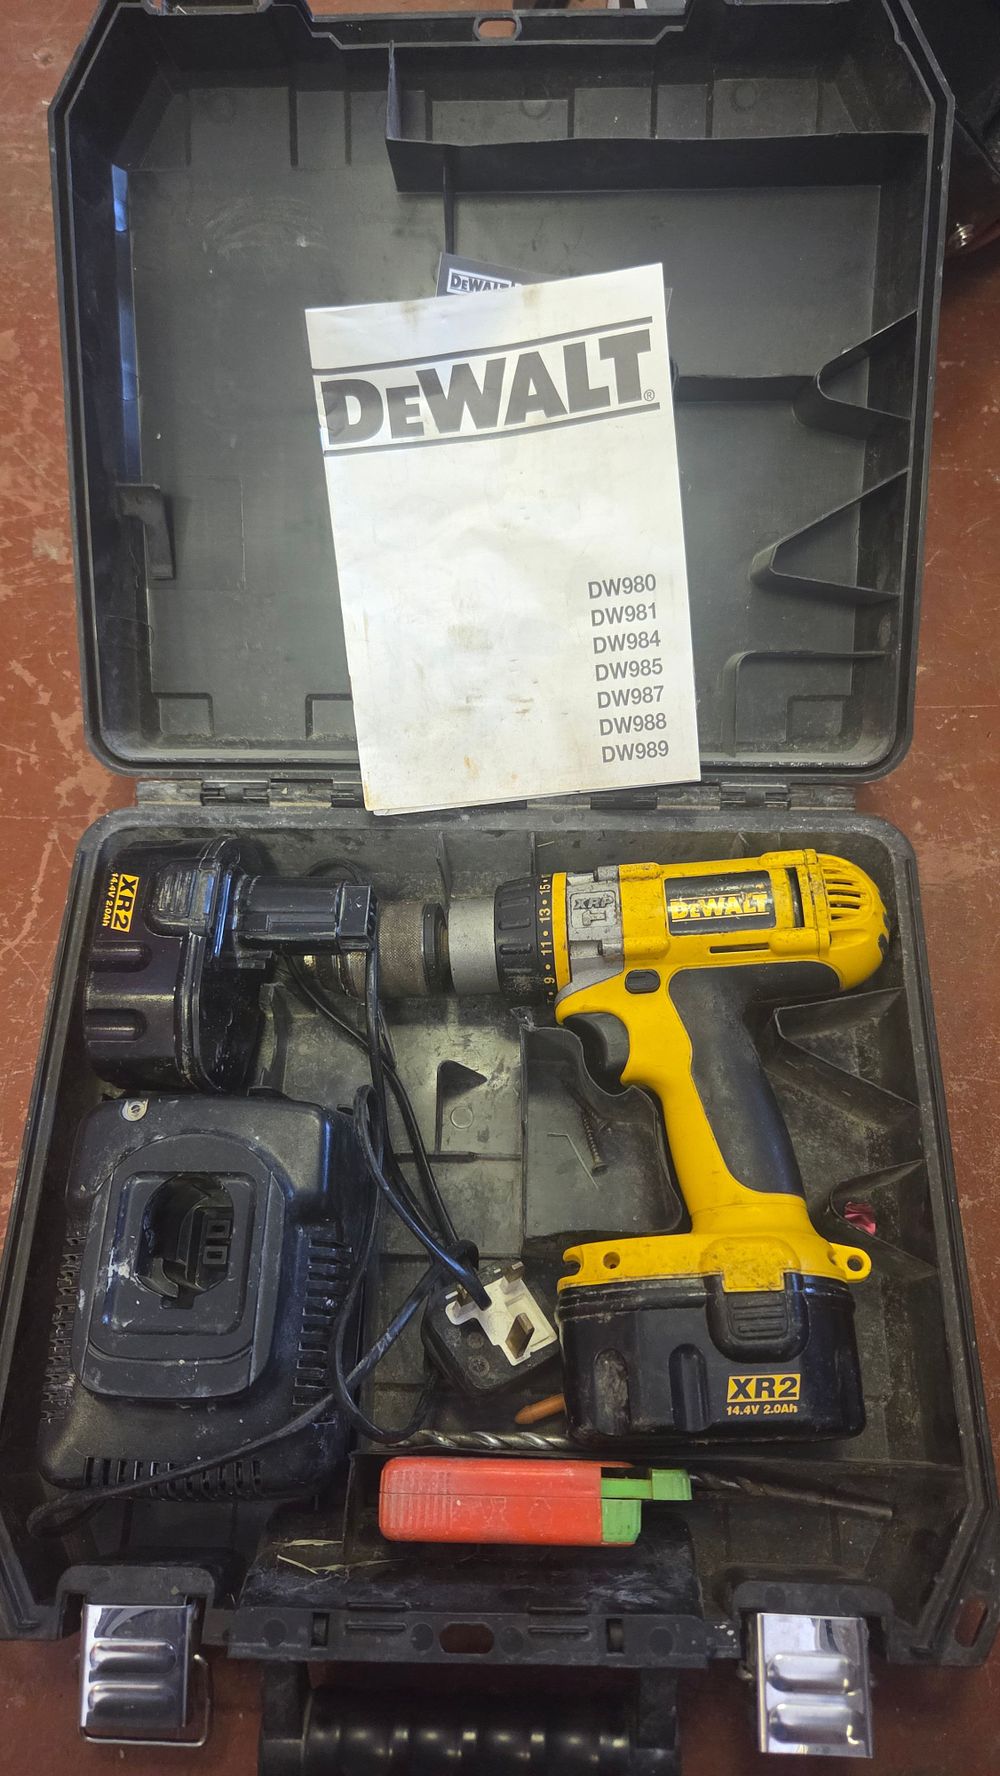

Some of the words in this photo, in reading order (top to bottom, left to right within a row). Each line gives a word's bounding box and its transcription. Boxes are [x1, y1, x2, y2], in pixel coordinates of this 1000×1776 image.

[450, 272, 510, 292] DEWA
[588, 573, 657, 600] DW980
[591, 602, 657, 627] DW981
[593, 630, 661, 655] DW984
[595, 658, 664, 682] DW985
[597, 685, 665, 709] DW987
[600, 712, 667, 737] DW988
[602, 740, 669, 764] DW989
[107, 872, 119, 898] 14.4V
[539, 884, 551, 895] 15
[101, 900, 114, 927] 2.0Ah
[112, 876, 138, 930] XR2
[669, 892, 769, 920] DEWALT
[539, 908, 551, 923] 13
[540, 941, 552, 956] 11
[544, 976, 556, 985] 9
[729, 1376, 798, 1400] XR2
[726, 1404, 760, 1416] 14.4V
[762, 1402, 798, 1415] 2.0Ah
